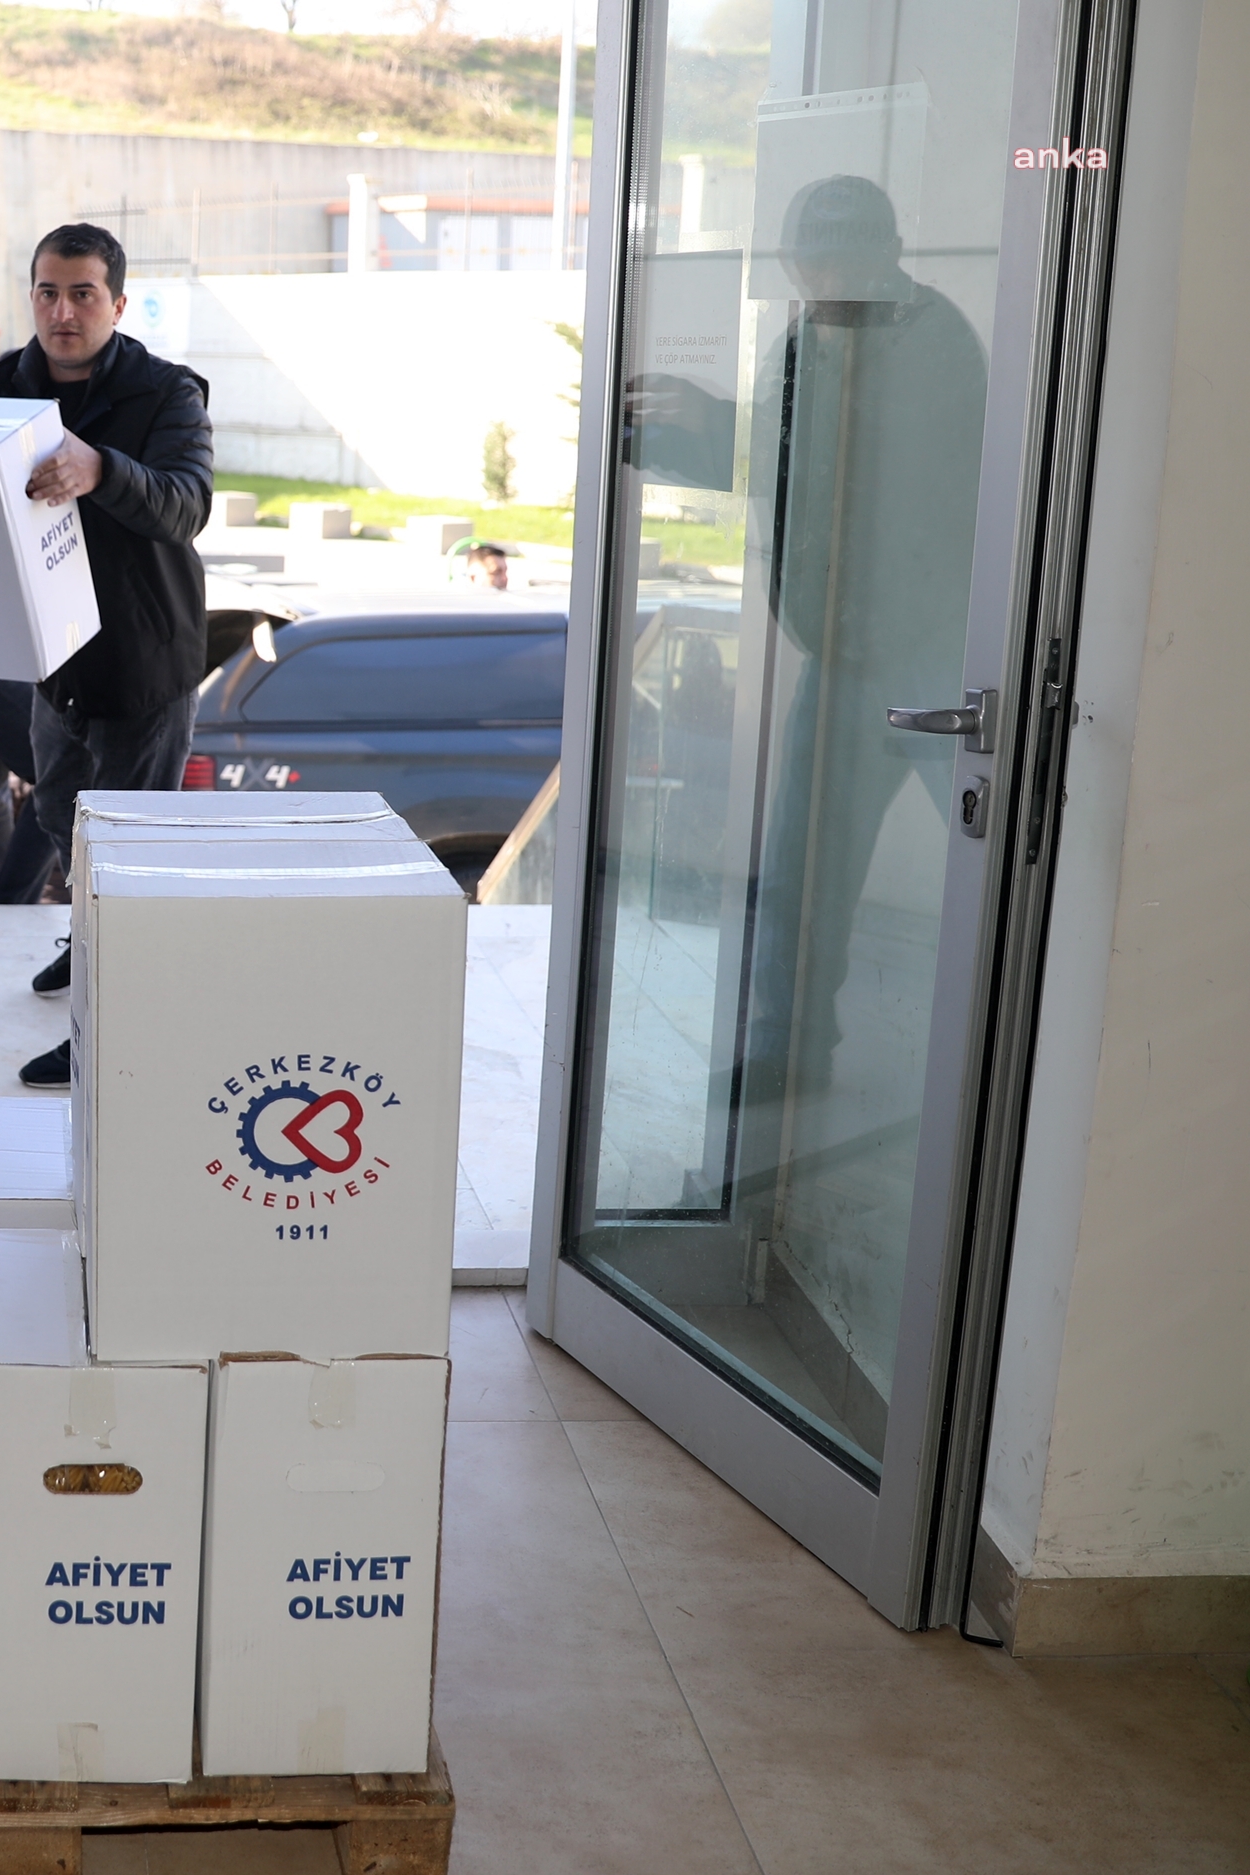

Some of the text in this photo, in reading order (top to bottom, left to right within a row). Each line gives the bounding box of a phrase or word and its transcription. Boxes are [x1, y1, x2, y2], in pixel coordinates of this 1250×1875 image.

[41, 511, 74, 552] AFİYET
[46, 533, 78, 571] OLSUN
[207, 1054, 402, 1114] ÇERKEZKÖY
[205, 1156, 391, 1210] BELEDİYESİ
[275, 1224, 328, 1240] 1911
[45, 1556, 172, 1587] AFİYET
[286, 1551, 411, 1582] AFİYET
[48, 1600, 165, 1625] OLSUN
[288, 1594, 404, 1619] OLSUN
